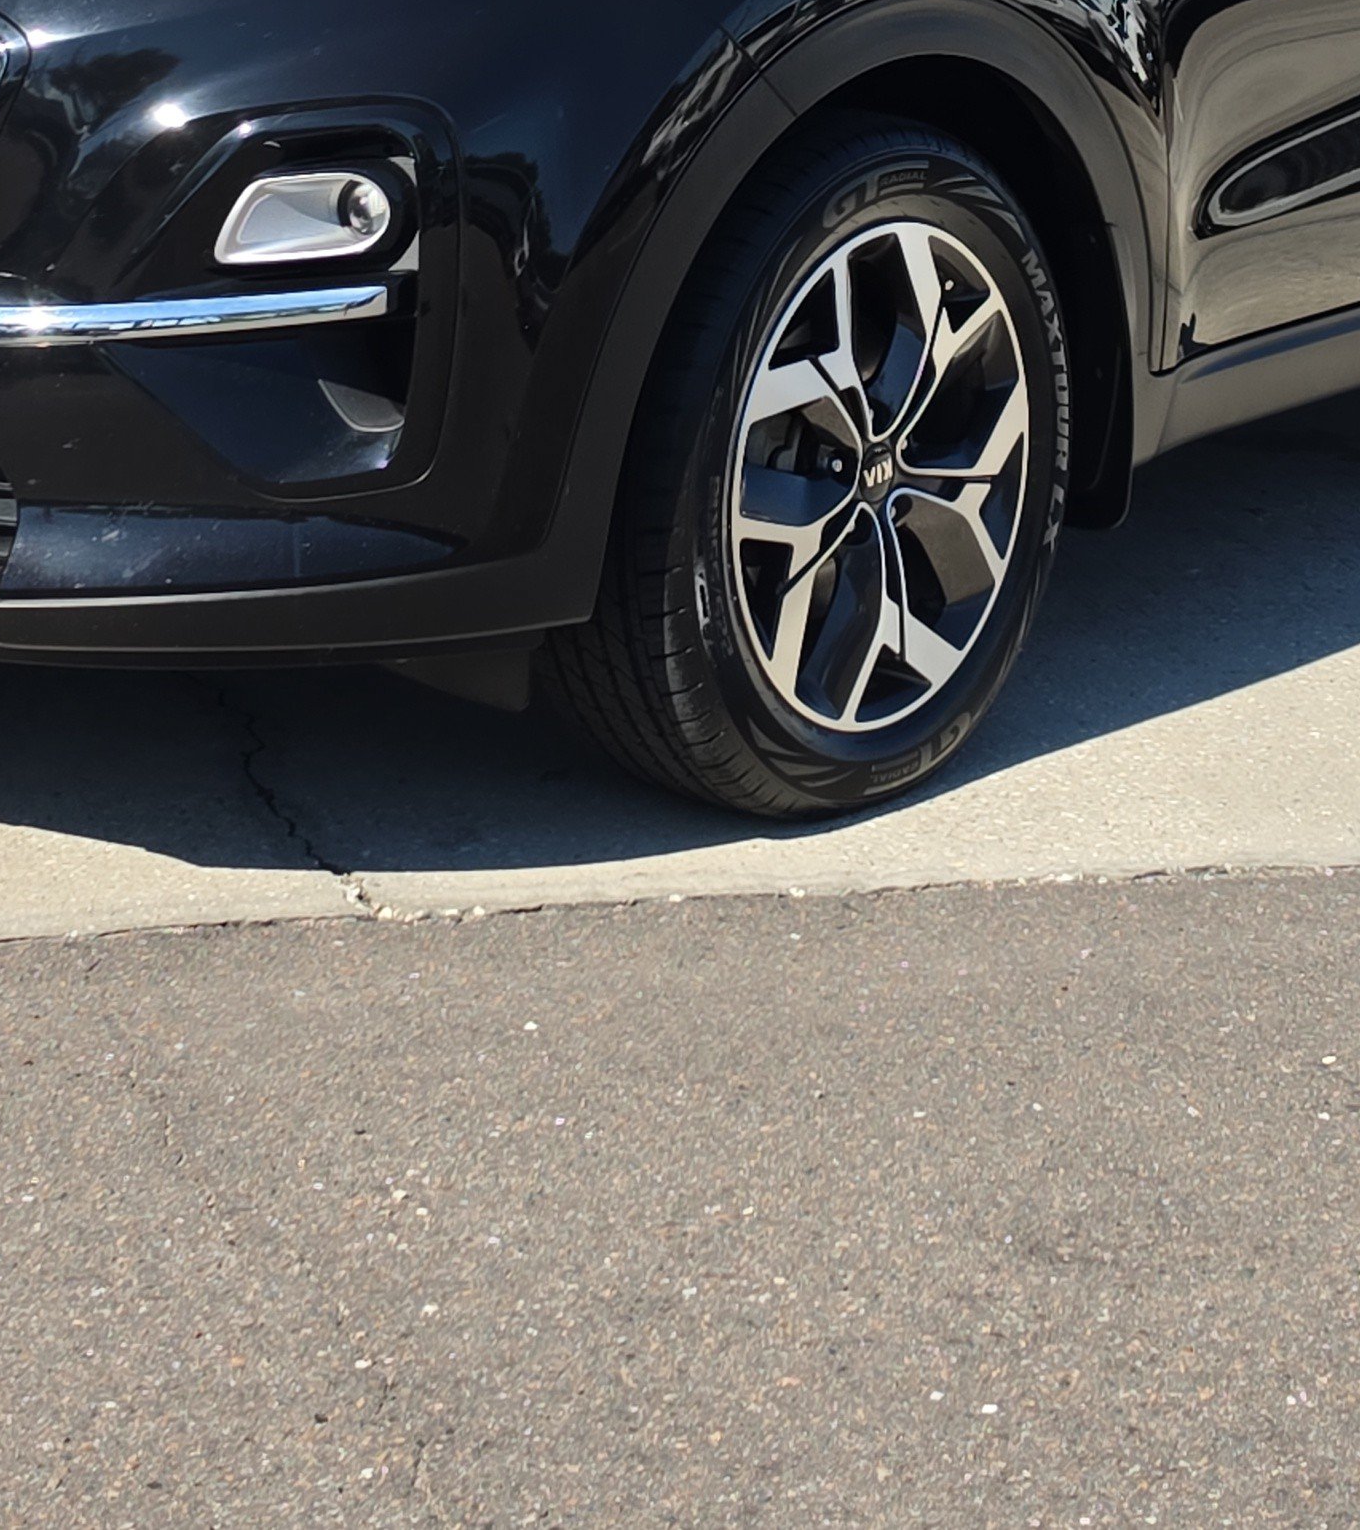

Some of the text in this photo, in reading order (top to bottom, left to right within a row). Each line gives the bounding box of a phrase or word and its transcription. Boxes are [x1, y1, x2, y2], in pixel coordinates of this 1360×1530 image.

[879, 170, 928, 187] RADIAL
[1020, 248, 1071, 554] MAXTOUR LX
[863, 457, 894, 488] KIA
